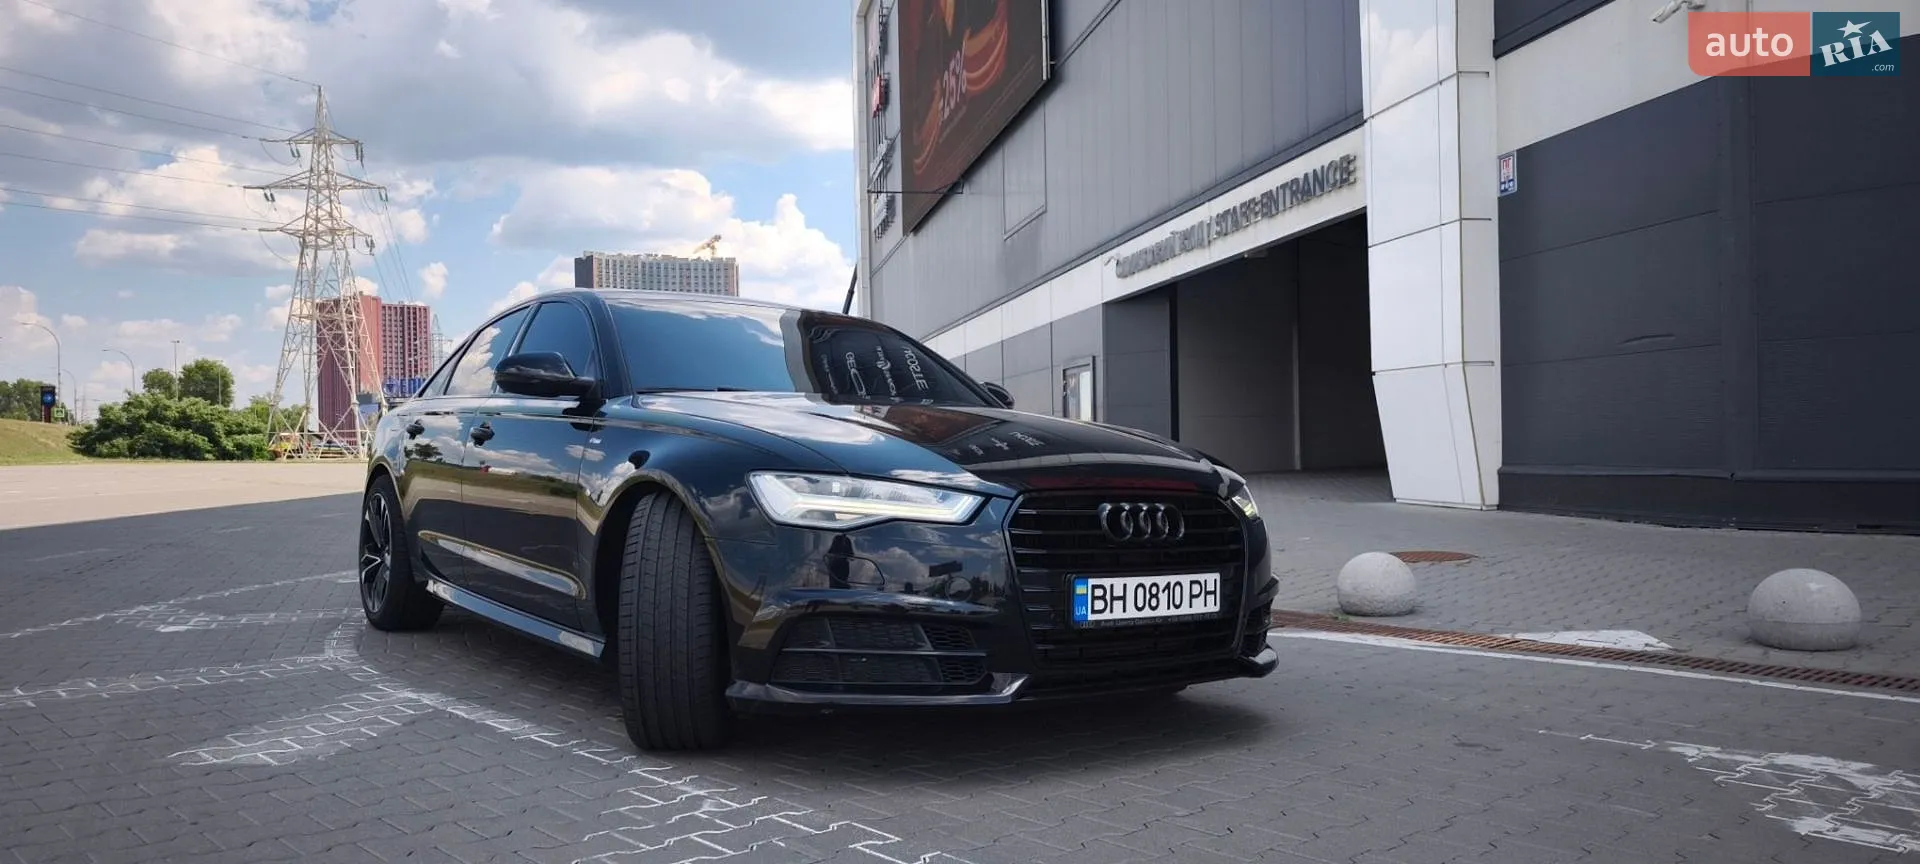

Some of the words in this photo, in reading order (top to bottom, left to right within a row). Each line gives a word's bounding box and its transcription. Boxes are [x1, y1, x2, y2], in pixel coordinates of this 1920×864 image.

[1215, 197, 1262, 239] STAFF
[1260, 153, 1357, 218] ENTRANCE
[1075, 605, 1087, 616] UA
[1090, 583, 1127, 615] BH
[1133, 580, 1183, 612] 0810
[1189, 578, 1217, 609] PH
